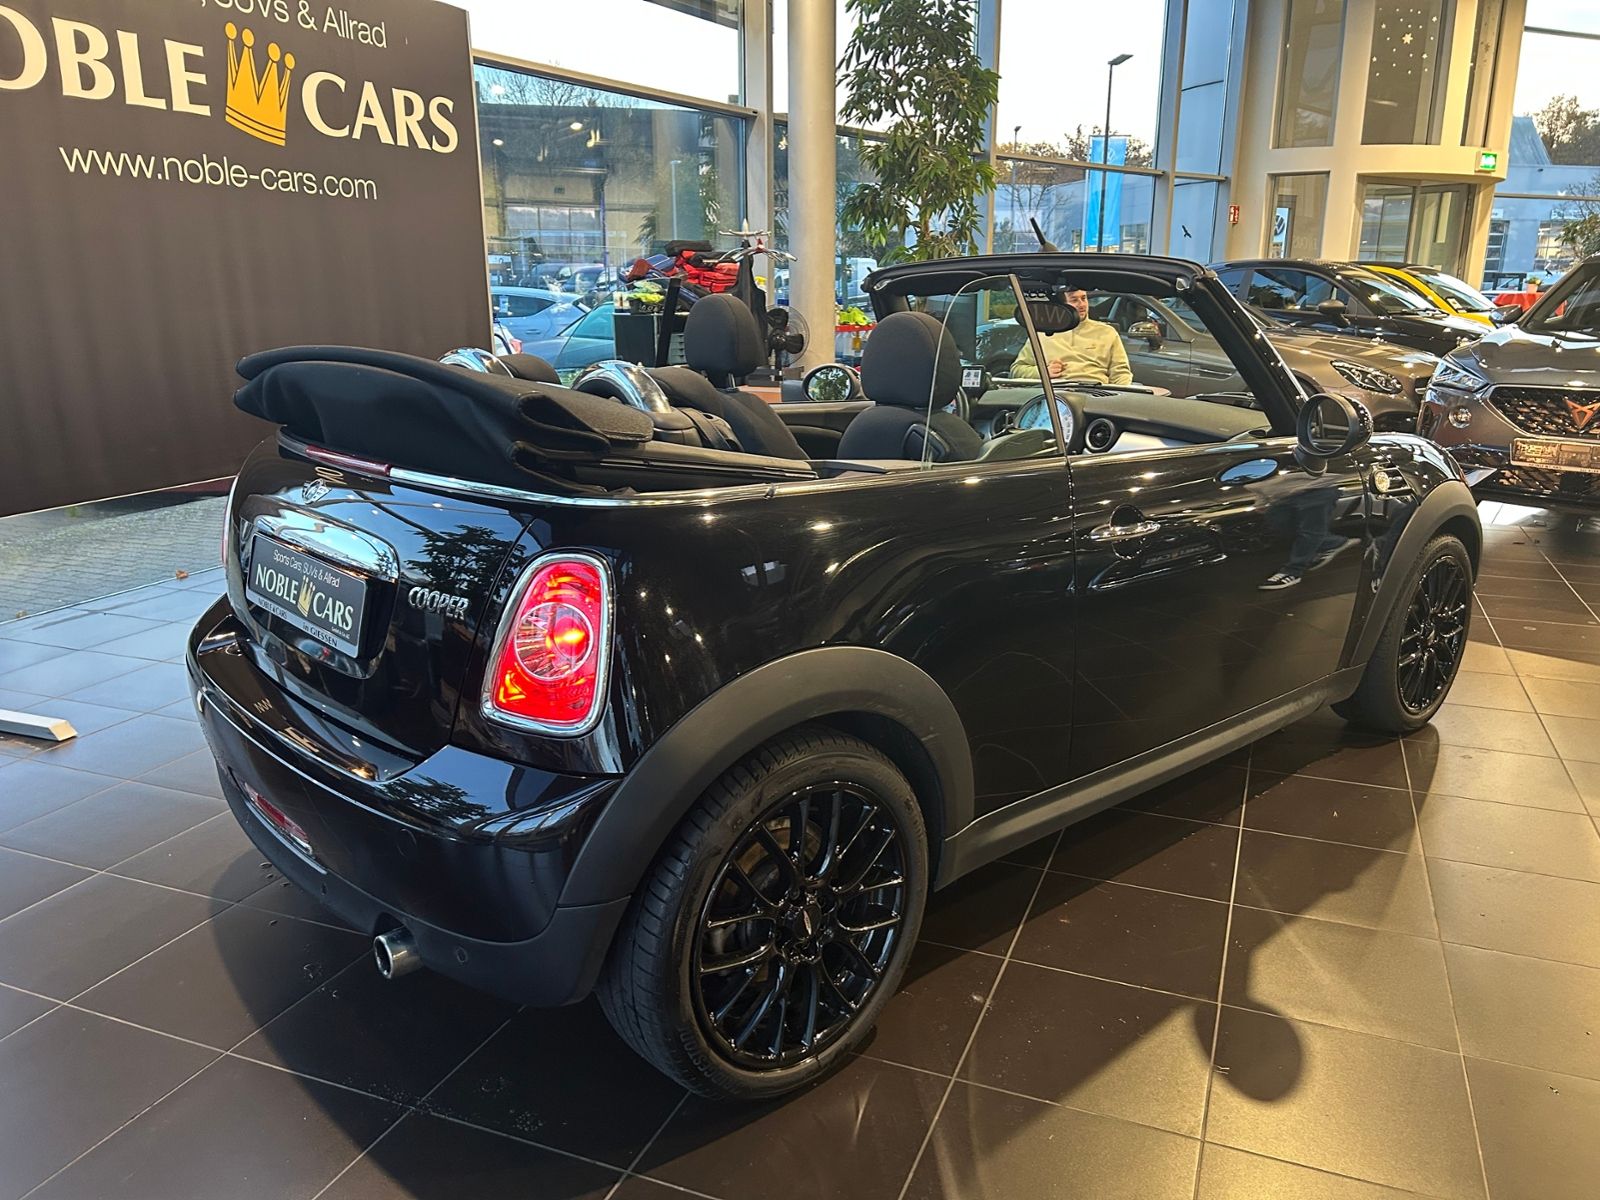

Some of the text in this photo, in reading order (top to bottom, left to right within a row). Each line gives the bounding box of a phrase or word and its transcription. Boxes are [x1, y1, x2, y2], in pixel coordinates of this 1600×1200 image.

[297, 0, 318, 31] &
[323, 6, 387, 49] Allrad
[301, 71, 459, 154] CARS
[58, 145, 378, 201] www.noble-cars.com
[255, 563, 354, 631] NOBLE CARS
[408, 586, 469, 620] COOPER
[302, 621, 309, 632] in
[310, 626, 338, 647] GIESSEN
